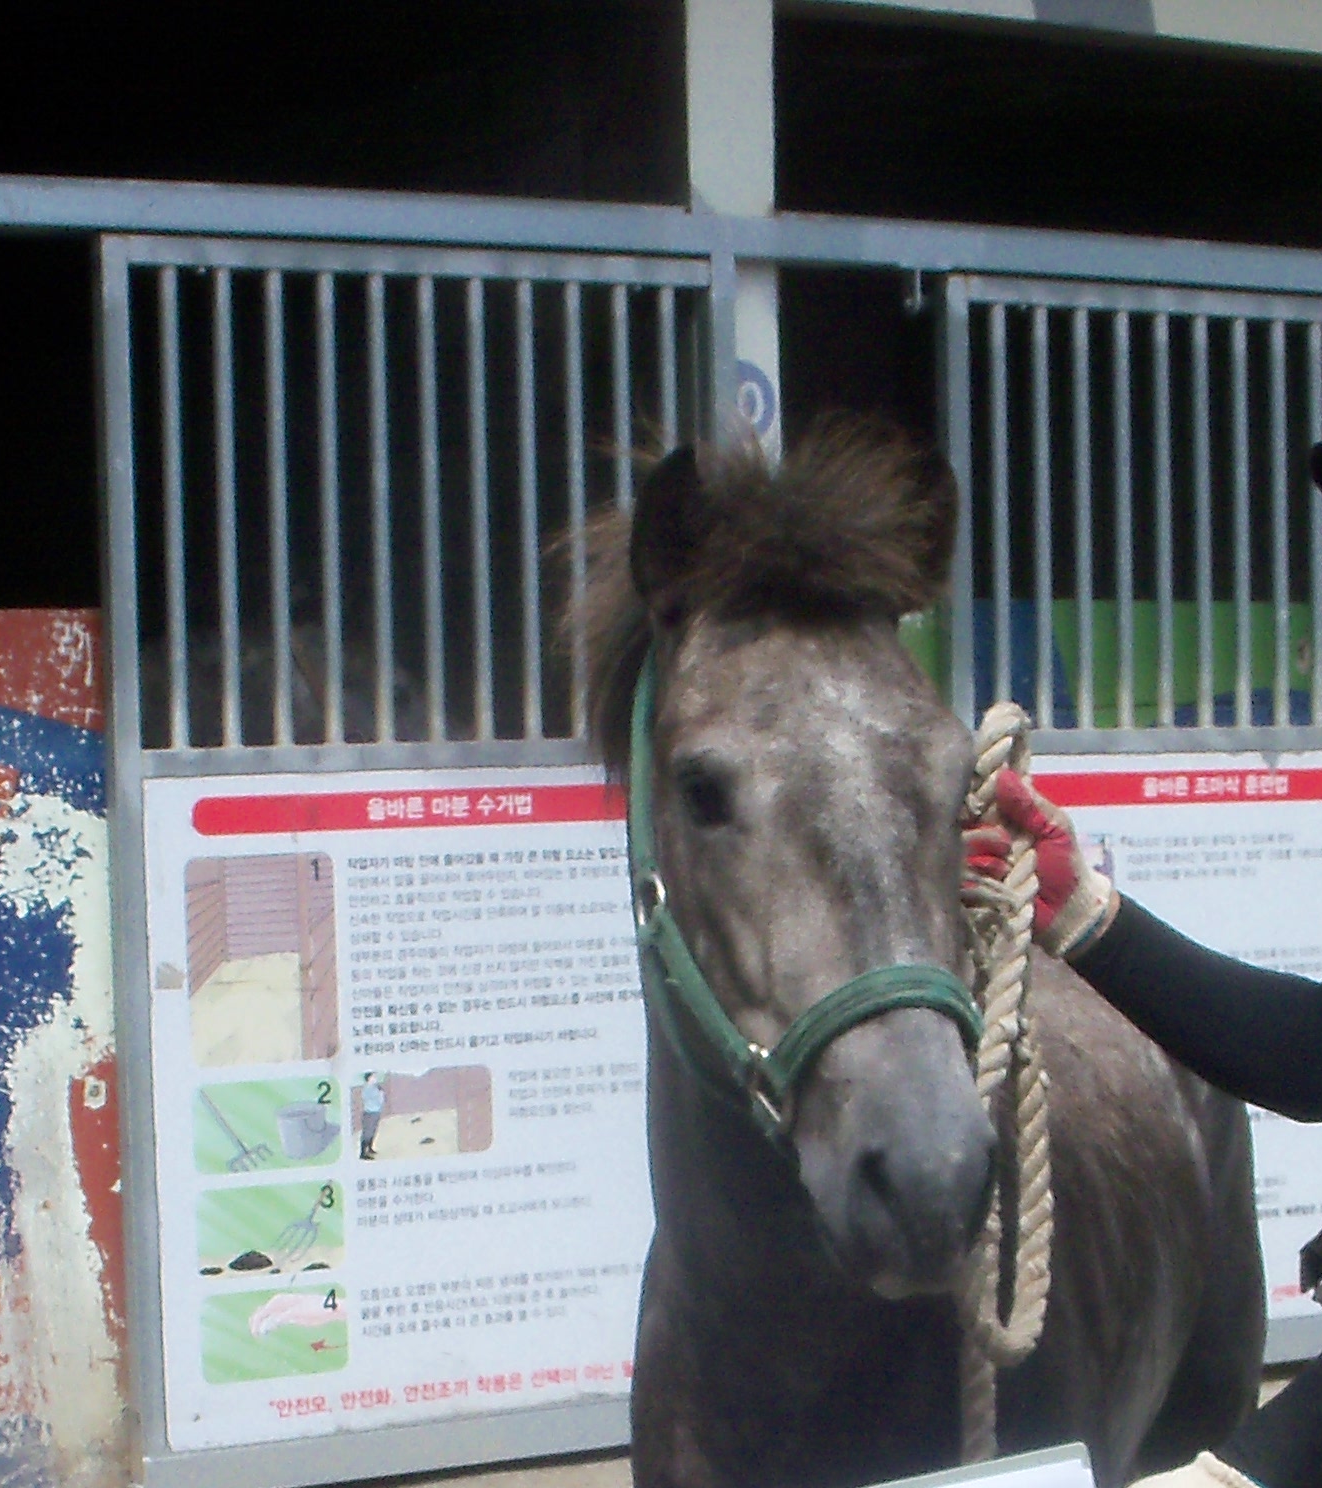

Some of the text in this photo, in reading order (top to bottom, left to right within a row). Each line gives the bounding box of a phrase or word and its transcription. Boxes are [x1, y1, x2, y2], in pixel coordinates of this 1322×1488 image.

[367, 793, 534, 821] 올바른 마분 수거법
[310, 859, 321, 881] 1
[316, 1082, 332, 1104] 2
[320, 1184, 334, 1208] 3
[323, 1289, 338, 1311] 4
[403, 1379, 468, 1403] 안전조끼
